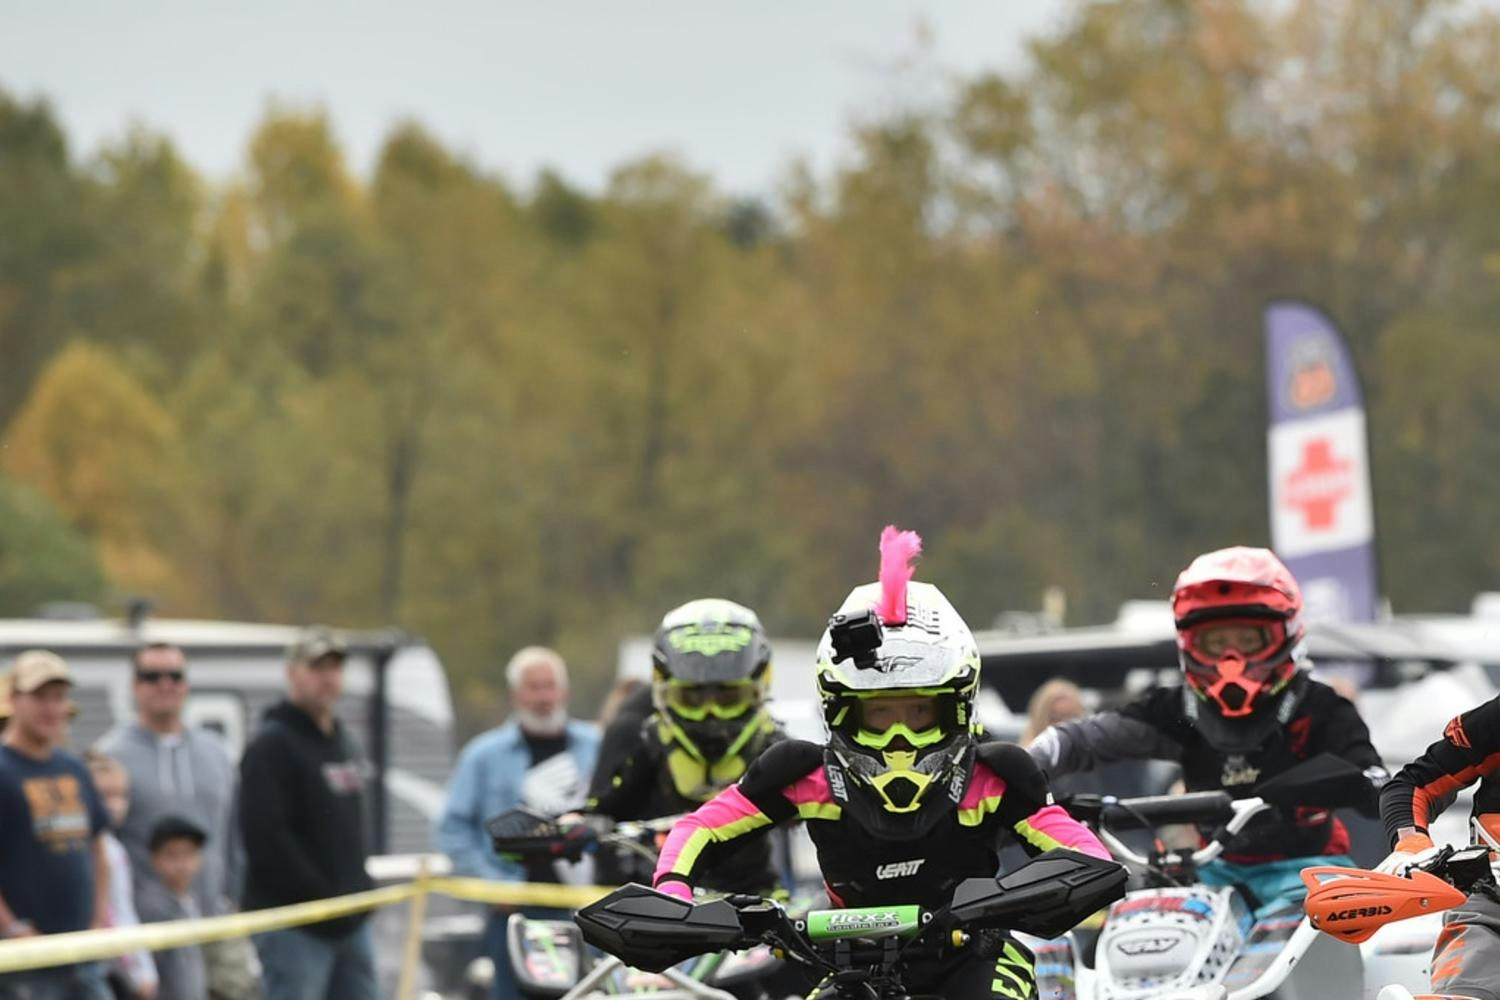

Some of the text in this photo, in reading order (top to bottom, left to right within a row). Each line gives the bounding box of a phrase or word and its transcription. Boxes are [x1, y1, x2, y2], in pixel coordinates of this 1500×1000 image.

[827, 764, 849, 802] LEATT
[948, 766, 968, 803] LEATT
[876, 859, 926, 880] LEATT
[1326, 905, 1393, 922] ACERBIS
